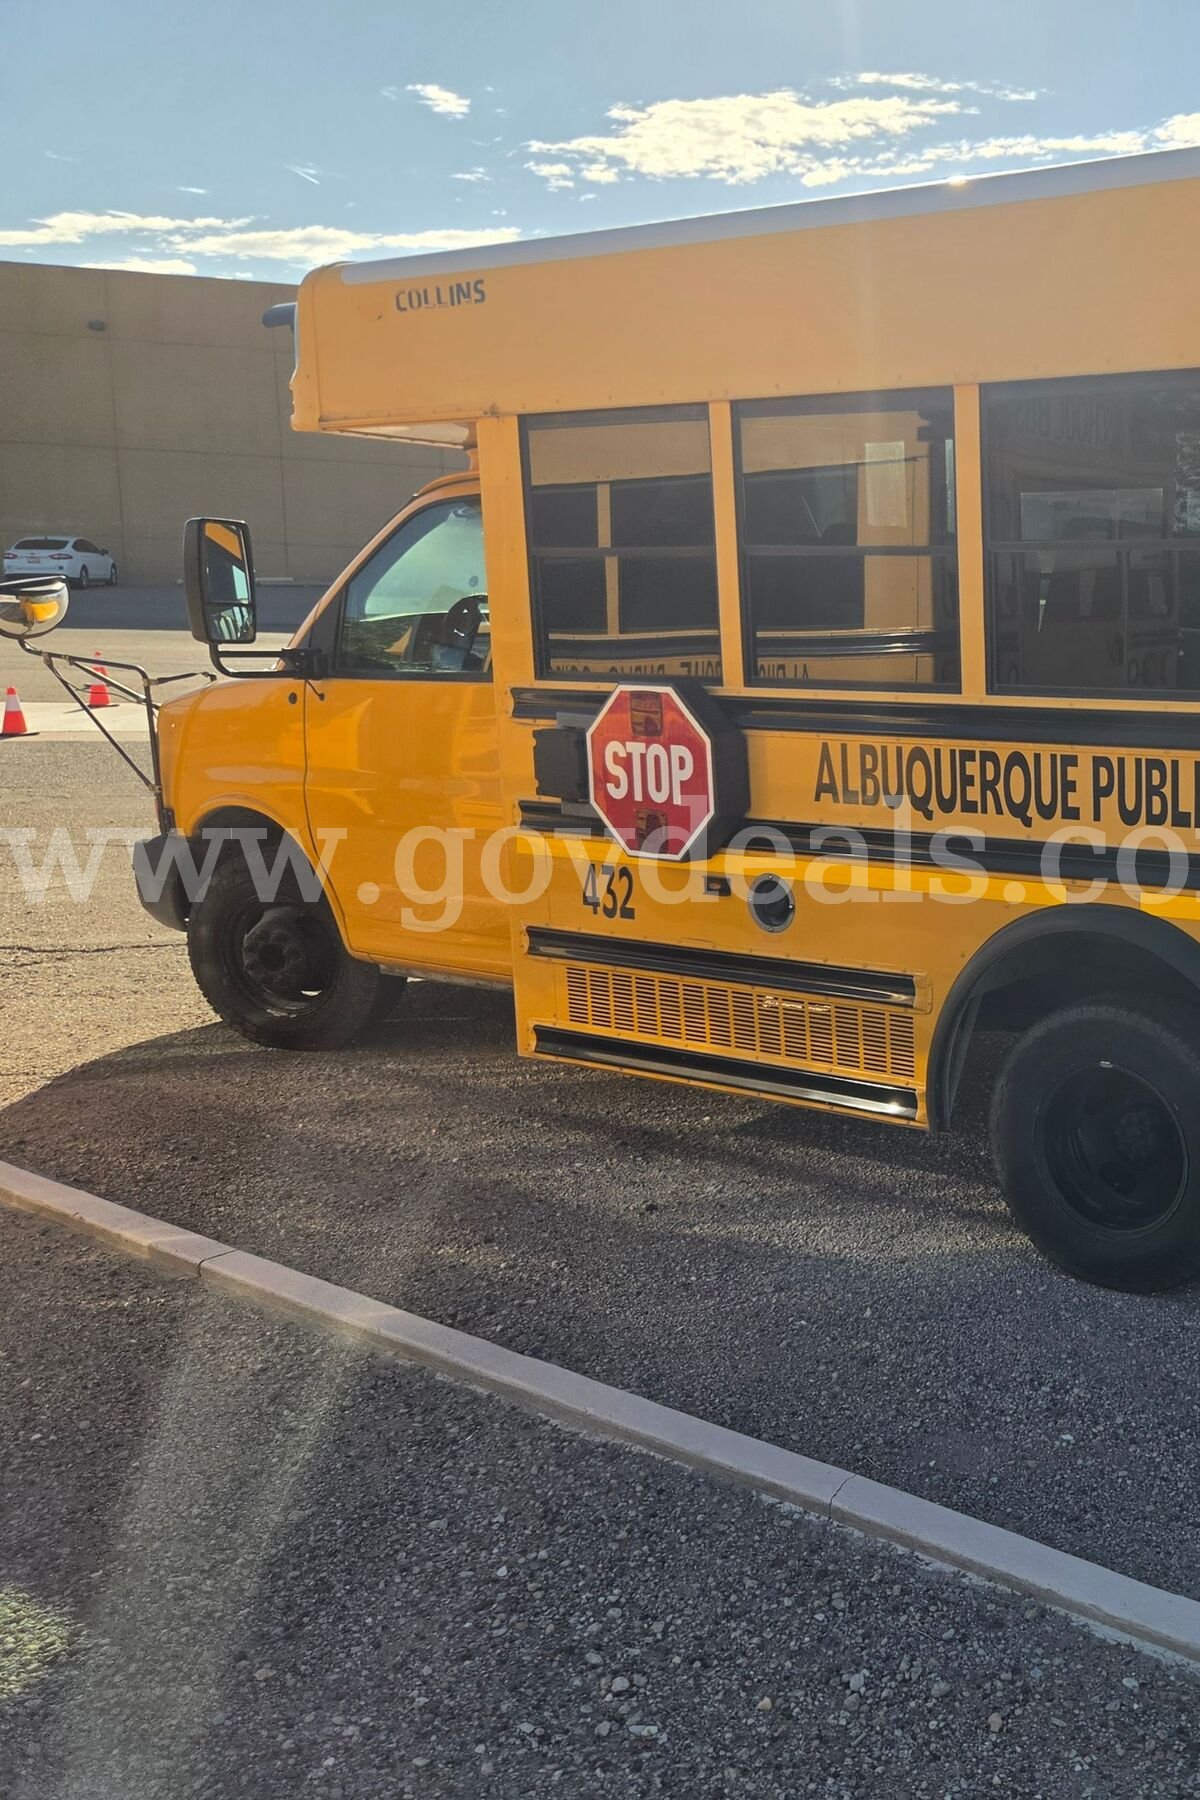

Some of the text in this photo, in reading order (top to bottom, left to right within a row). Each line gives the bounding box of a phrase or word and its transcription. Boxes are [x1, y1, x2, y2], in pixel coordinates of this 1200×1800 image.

[395, 278, 486, 312] COLLINS
[604, 740, 694, 805] STOP
[814, 740, 1081, 827] ALBUQUERQUE
[582, 863, 636, 920] 432
